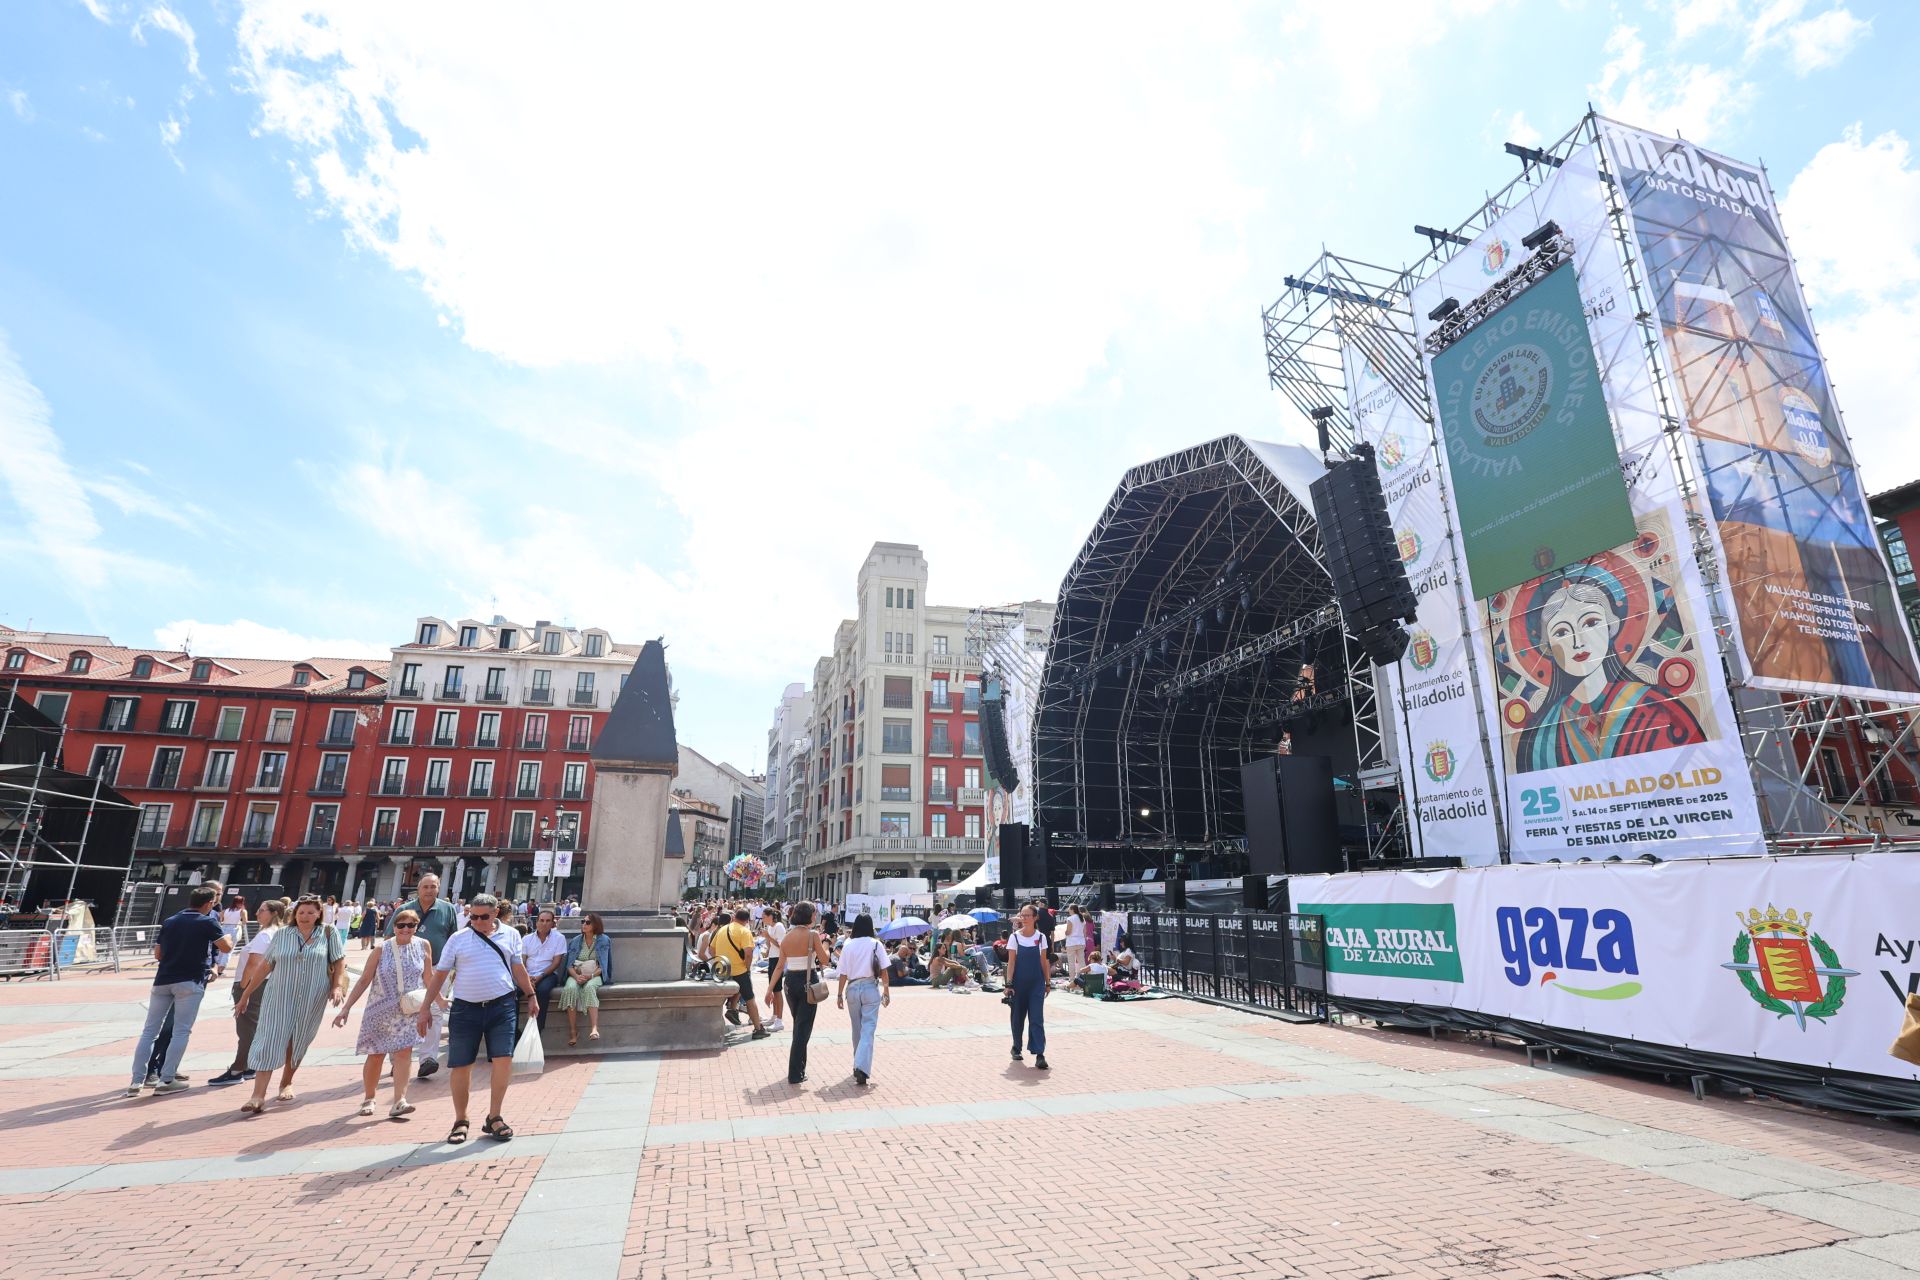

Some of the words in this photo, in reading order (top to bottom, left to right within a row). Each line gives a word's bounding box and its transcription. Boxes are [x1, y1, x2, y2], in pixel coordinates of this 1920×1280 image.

[1605, 126, 1769, 211] Mahou
[1668, 181, 1756, 219] TOSTADA
[1461, 315, 1518, 372] CERO
[1481, 350, 1514, 385] MISSION
[1516, 348, 1541, 364] LABEL
[1524, 309, 1590, 427] EMISIONES
[1445, 379, 1523, 477] VALLADOLID
[1490, 409, 1546, 446] VALLADOLID
[1414, 571, 1448, 597] dolid
[1764, 584, 1822, 602] VALLADOLID
[1823, 594, 1836, 604] EN
[1792, 599, 1805, 609] TÚ
[1779, 610, 1815, 623] MAHOU
[1832, 619, 1872, 633] TOSTADA
[1797, 624, 1812, 634] TE
[1452, 669, 1463, 680] de
[1472, 787, 1484, 797] de
[1569, 767, 1722, 801] VALLADOLID
[1413, 799, 1488, 823] Valladolid
[1520, 786, 1561, 816] 25
[1572, 808, 1578, 817] 5
[1588, 807, 1598, 816] 14
[1609, 796, 1684, 813] SEPTIEMBRE
[1700, 791, 1729, 803] 2025
[1524, 816, 1563, 825] ANIVERSARIO
[1526, 827, 1558, 838] FERIA
[1562, 825, 1570, 835] Y
[1575, 820, 1622, 834] FIESTAS
[1626, 818, 1645, 829] DE
[1650, 815, 1670, 827] LA
[1673, 809, 1734, 825] VIRGEN
[1566, 837, 1584, 847] DE
[1585, 834, 1610, 845] SAN
[1613, 829, 1677, 843] LORENZO
[1132, 915, 1151, 925] BLAPE
[1157, 917, 1178, 927] BLAPE
[1185, 917, 1209, 928] BLAPE
[1218, 918, 1243, 930] BLAPE
[1252, 919, 1278, 932] BLAPE
[1288, 919, 1317, 932] BLAPE
[1325, 926, 1371, 950] CAJA
[1376, 927, 1454, 953] RURAL
[1496, 906, 1639, 987] gaza
[1343, 949, 1363, 963] DE
[1366, 950, 1435, 966] ZAMORA
